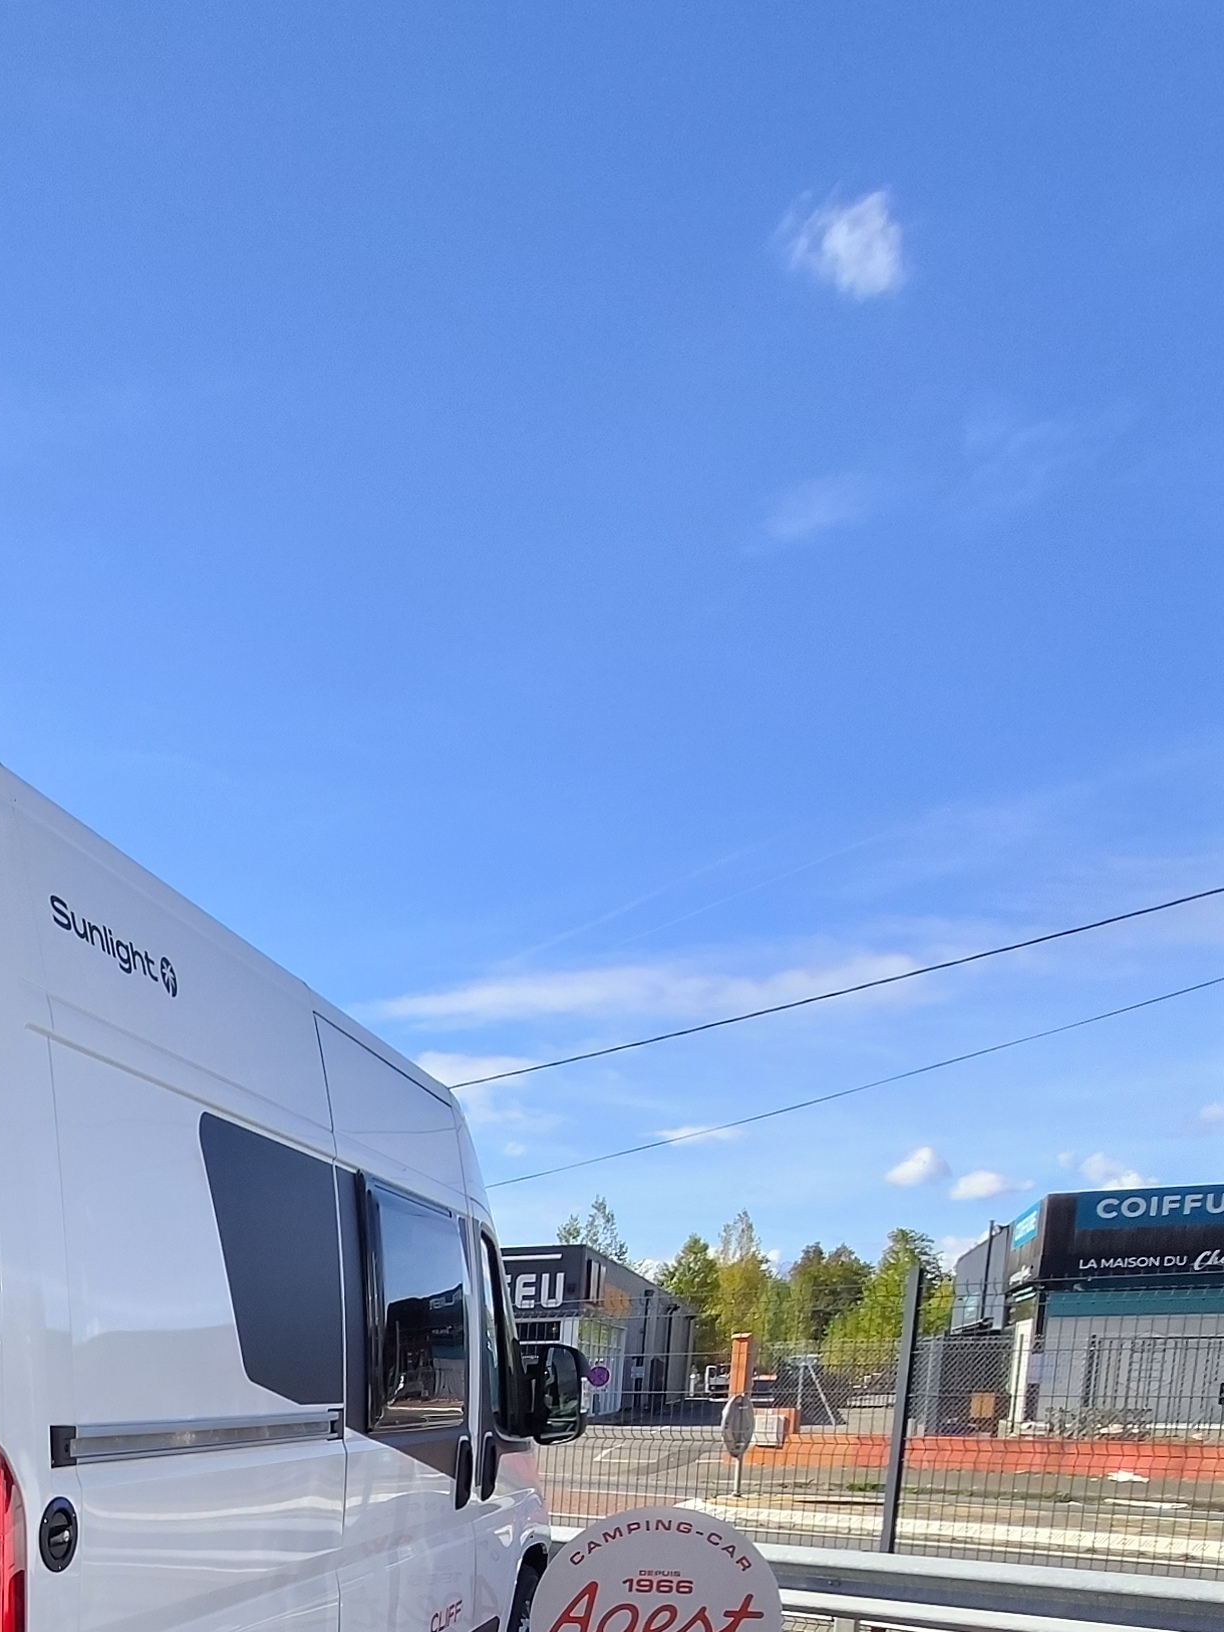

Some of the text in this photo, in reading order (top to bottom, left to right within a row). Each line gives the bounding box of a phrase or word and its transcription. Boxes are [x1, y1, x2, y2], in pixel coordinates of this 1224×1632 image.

[50, 895, 158, 982] Sunlight
[1079, 1259, 1097, 1269] LA
[1100, 1257, 1160, 1268] MAISON
[1163, 1255, 1187, 1267] DU
[506, 1273, 565, 1309] EU
[569, 1519, 752, 1572] CAMPING-CAR
[622, 1578, 693, 1594] 1966
